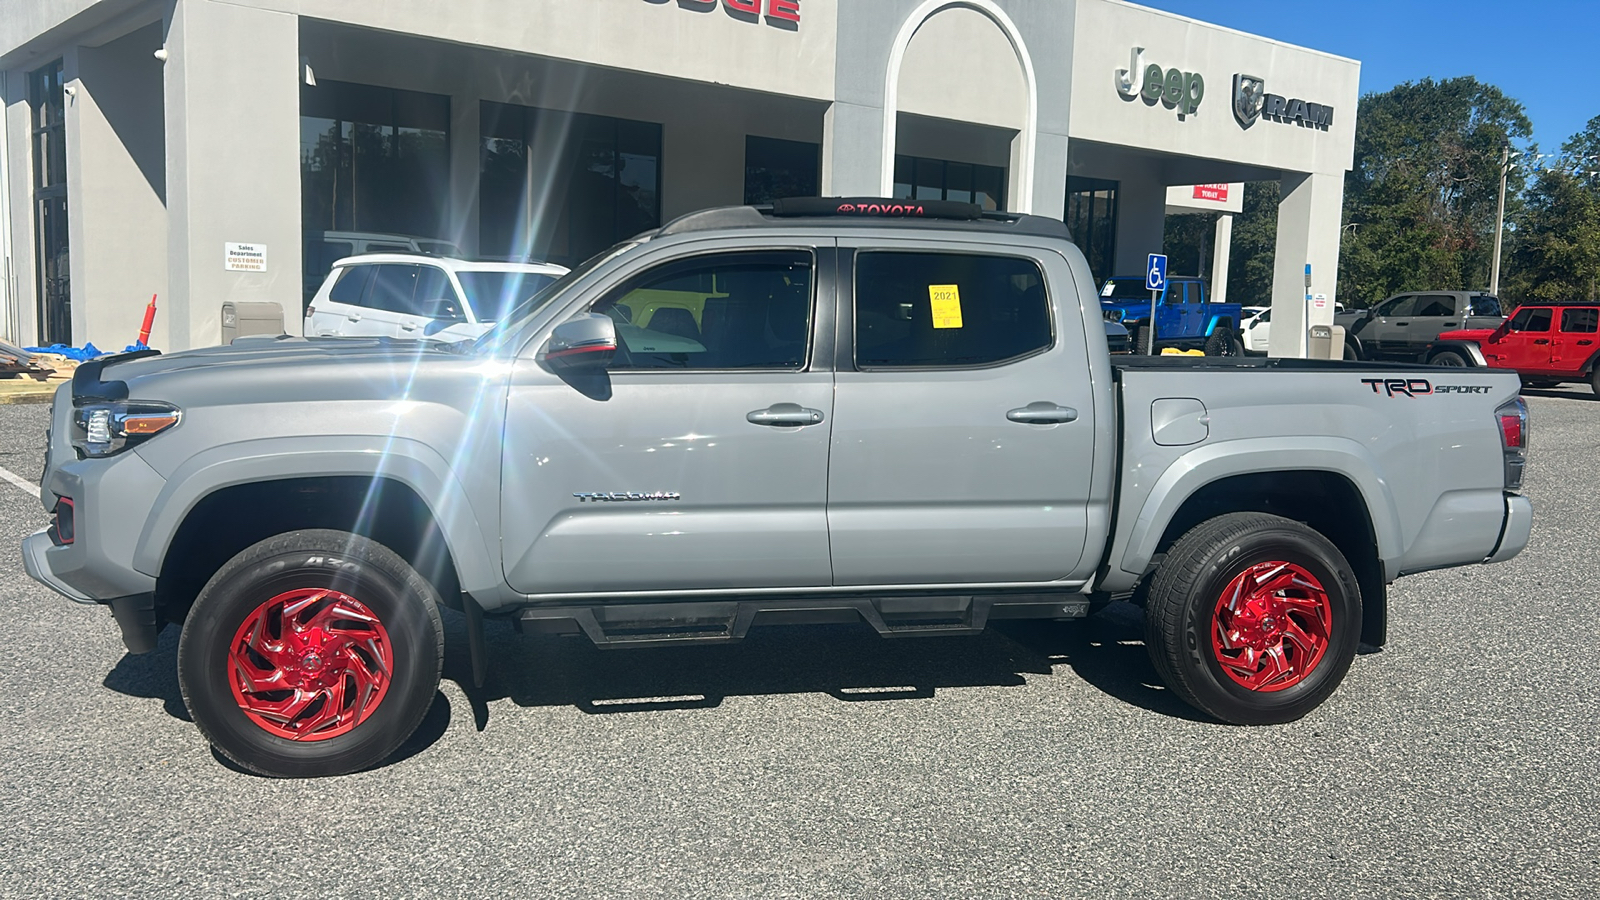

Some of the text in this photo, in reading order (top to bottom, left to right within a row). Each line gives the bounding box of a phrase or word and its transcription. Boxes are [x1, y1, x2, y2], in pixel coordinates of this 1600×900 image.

[1115, 47, 1205, 122] Jeep
[1262, 93, 1334, 132] RAM
[1201, 190, 1218, 198] TODAY
[857, 204, 924, 215] TOYOTA
[934, 291, 957, 301] 2021
[1360, 378, 1493, 399] TRD SPORT
[572, 491, 680, 502] TACOMA
